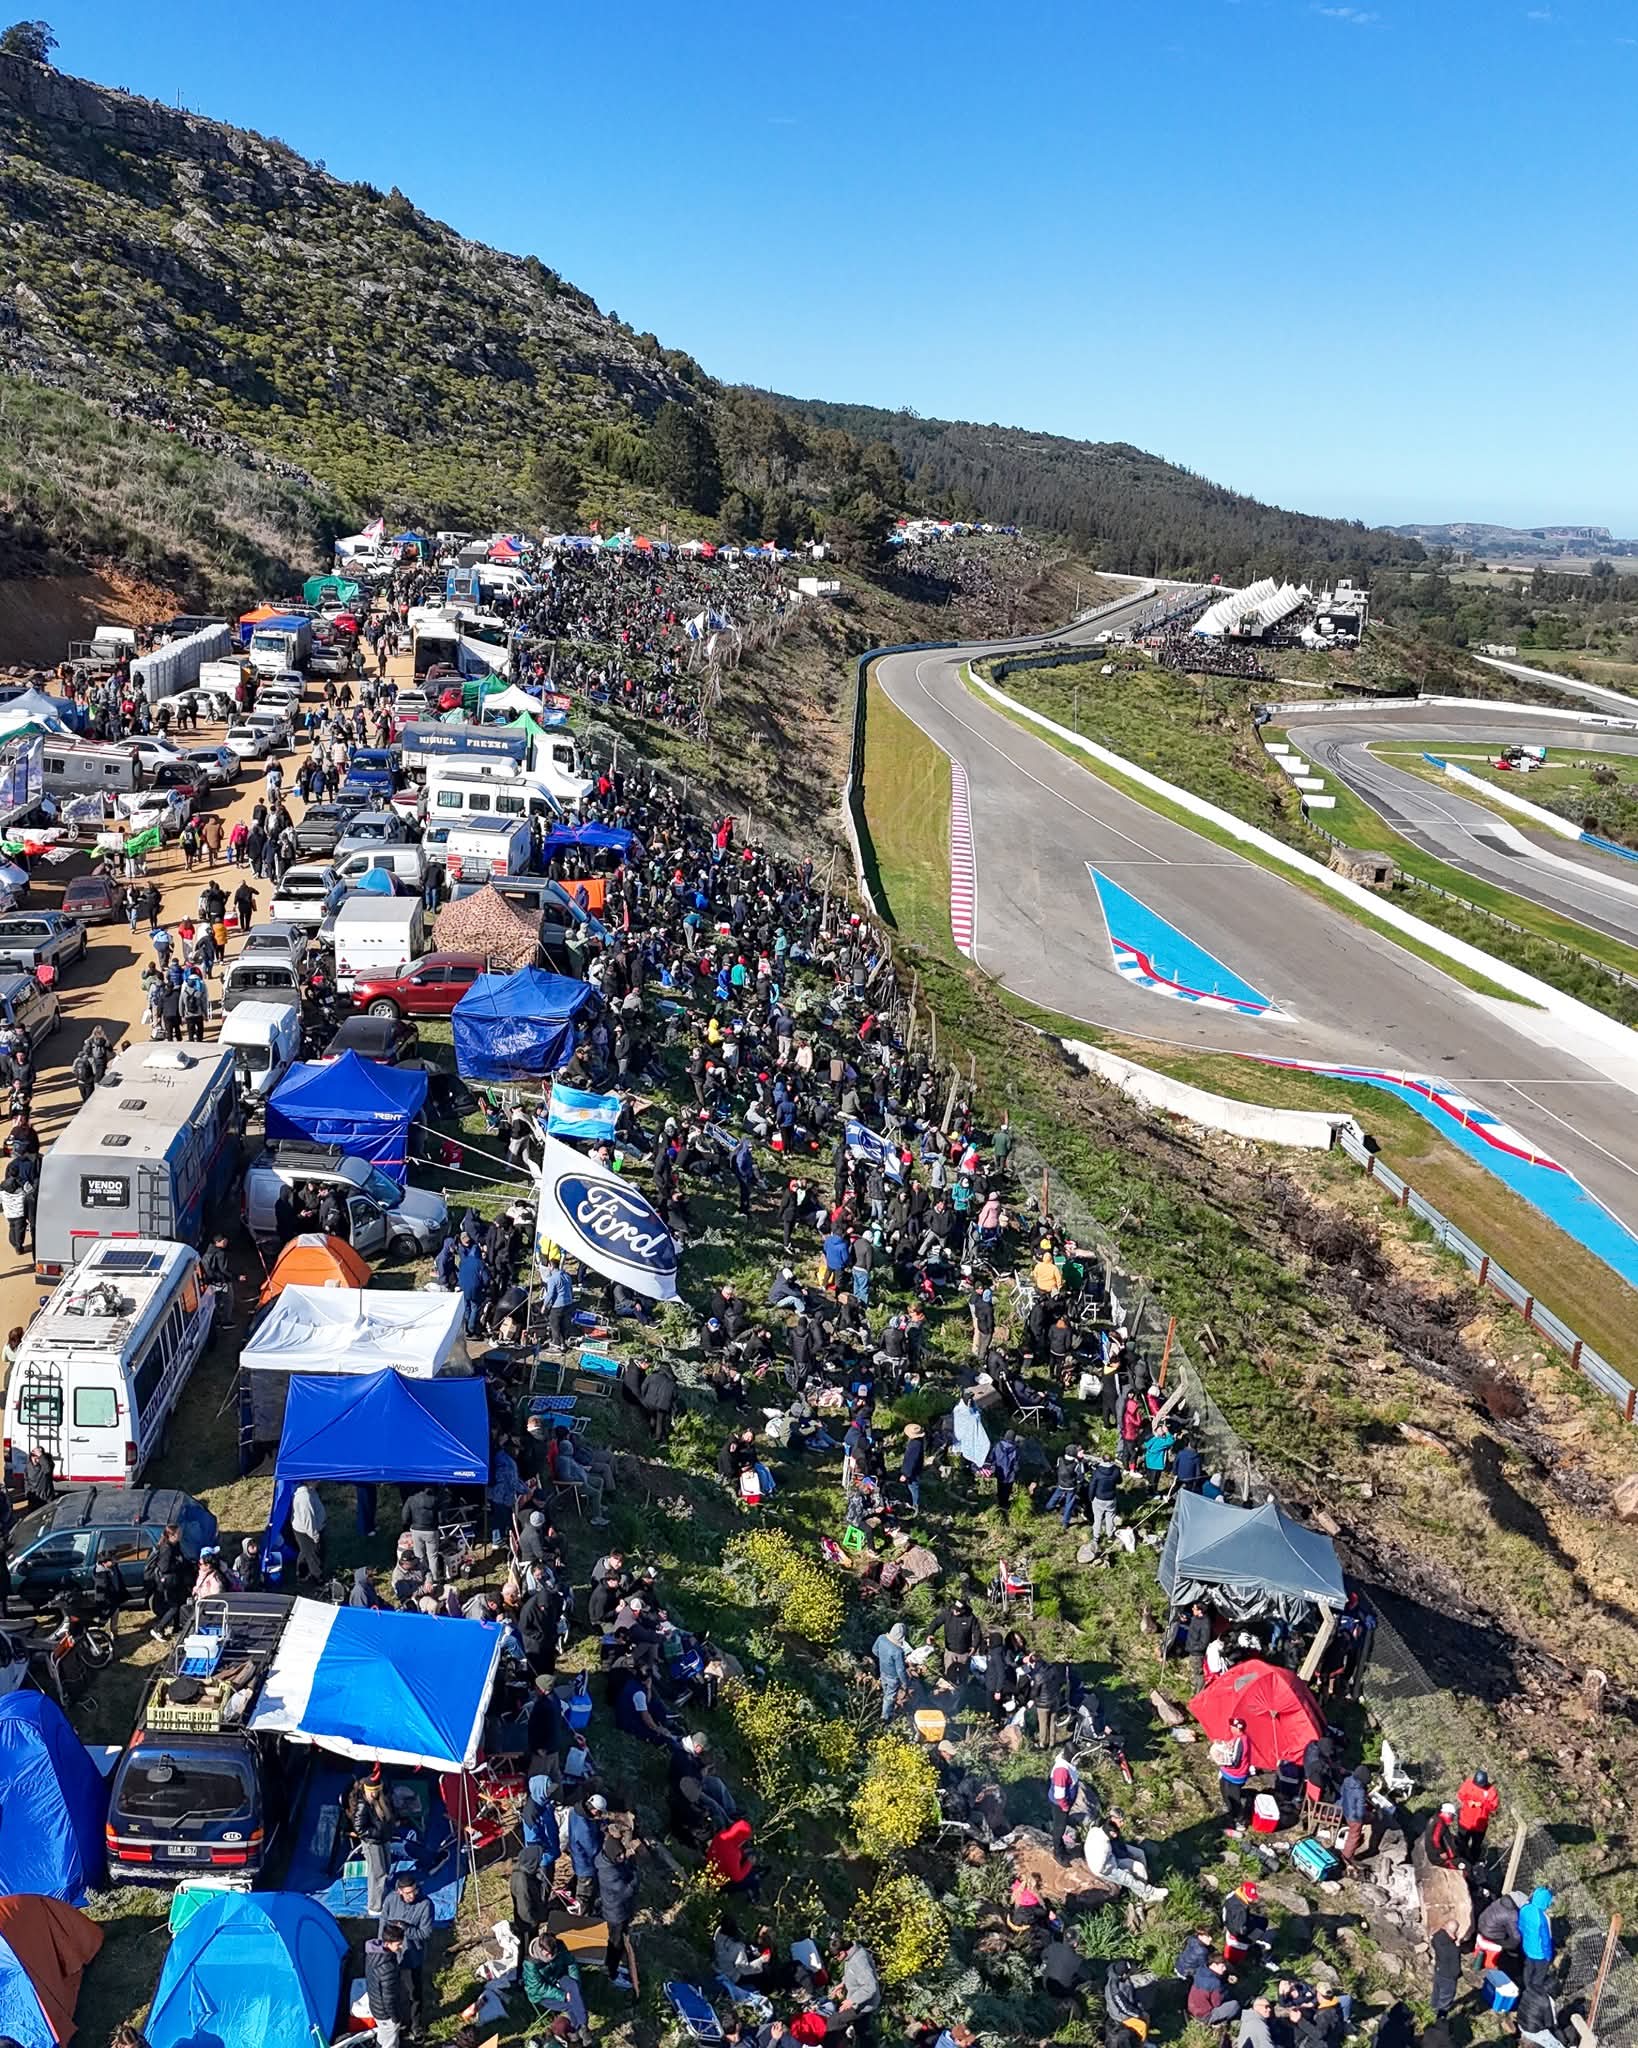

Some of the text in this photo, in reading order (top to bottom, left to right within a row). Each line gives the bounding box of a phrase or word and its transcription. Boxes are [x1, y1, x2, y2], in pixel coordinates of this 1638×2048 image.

[374, 1112, 403, 1121] TRENT
[88, 1180, 122, 1189] VENDO
[577, 1186, 668, 1258] Ford
[1303, 1590, 1338, 1604] TRENT
